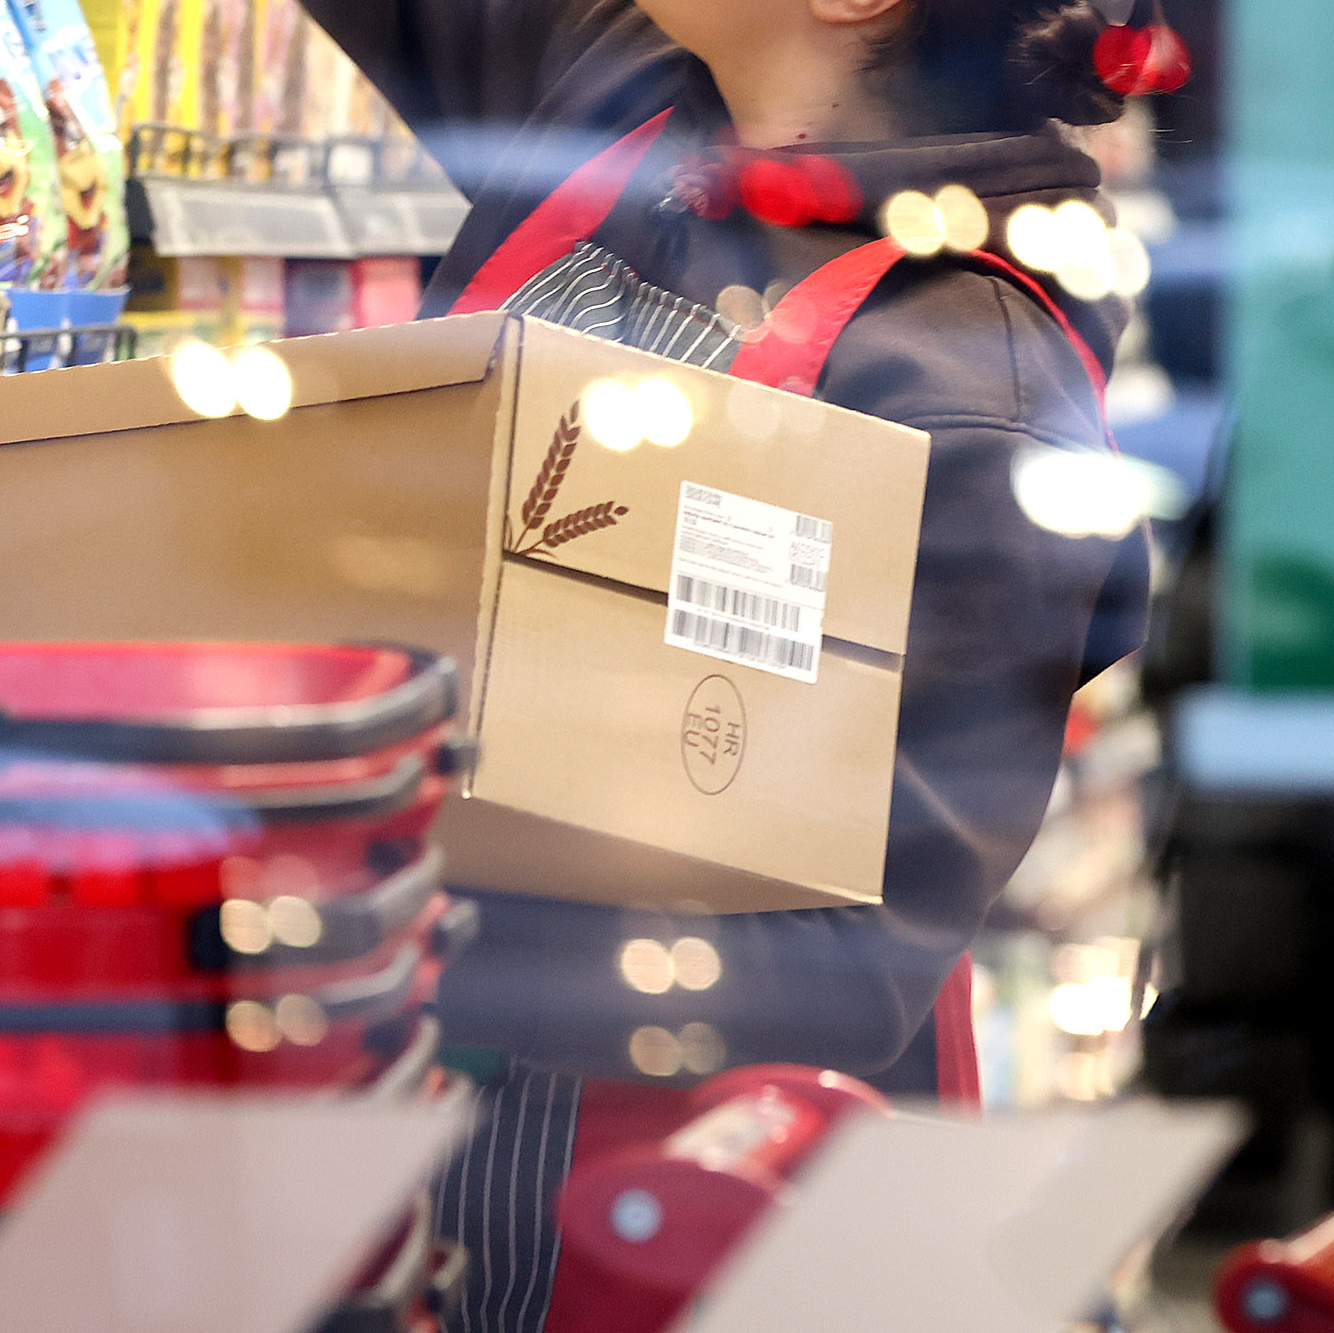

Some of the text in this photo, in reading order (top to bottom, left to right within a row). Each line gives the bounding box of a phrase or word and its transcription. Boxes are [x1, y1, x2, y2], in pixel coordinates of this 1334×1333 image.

[683, 713, 702, 747] EU
[699, 707, 721, 765] 1077
[723, 722, 740, 756] HR
